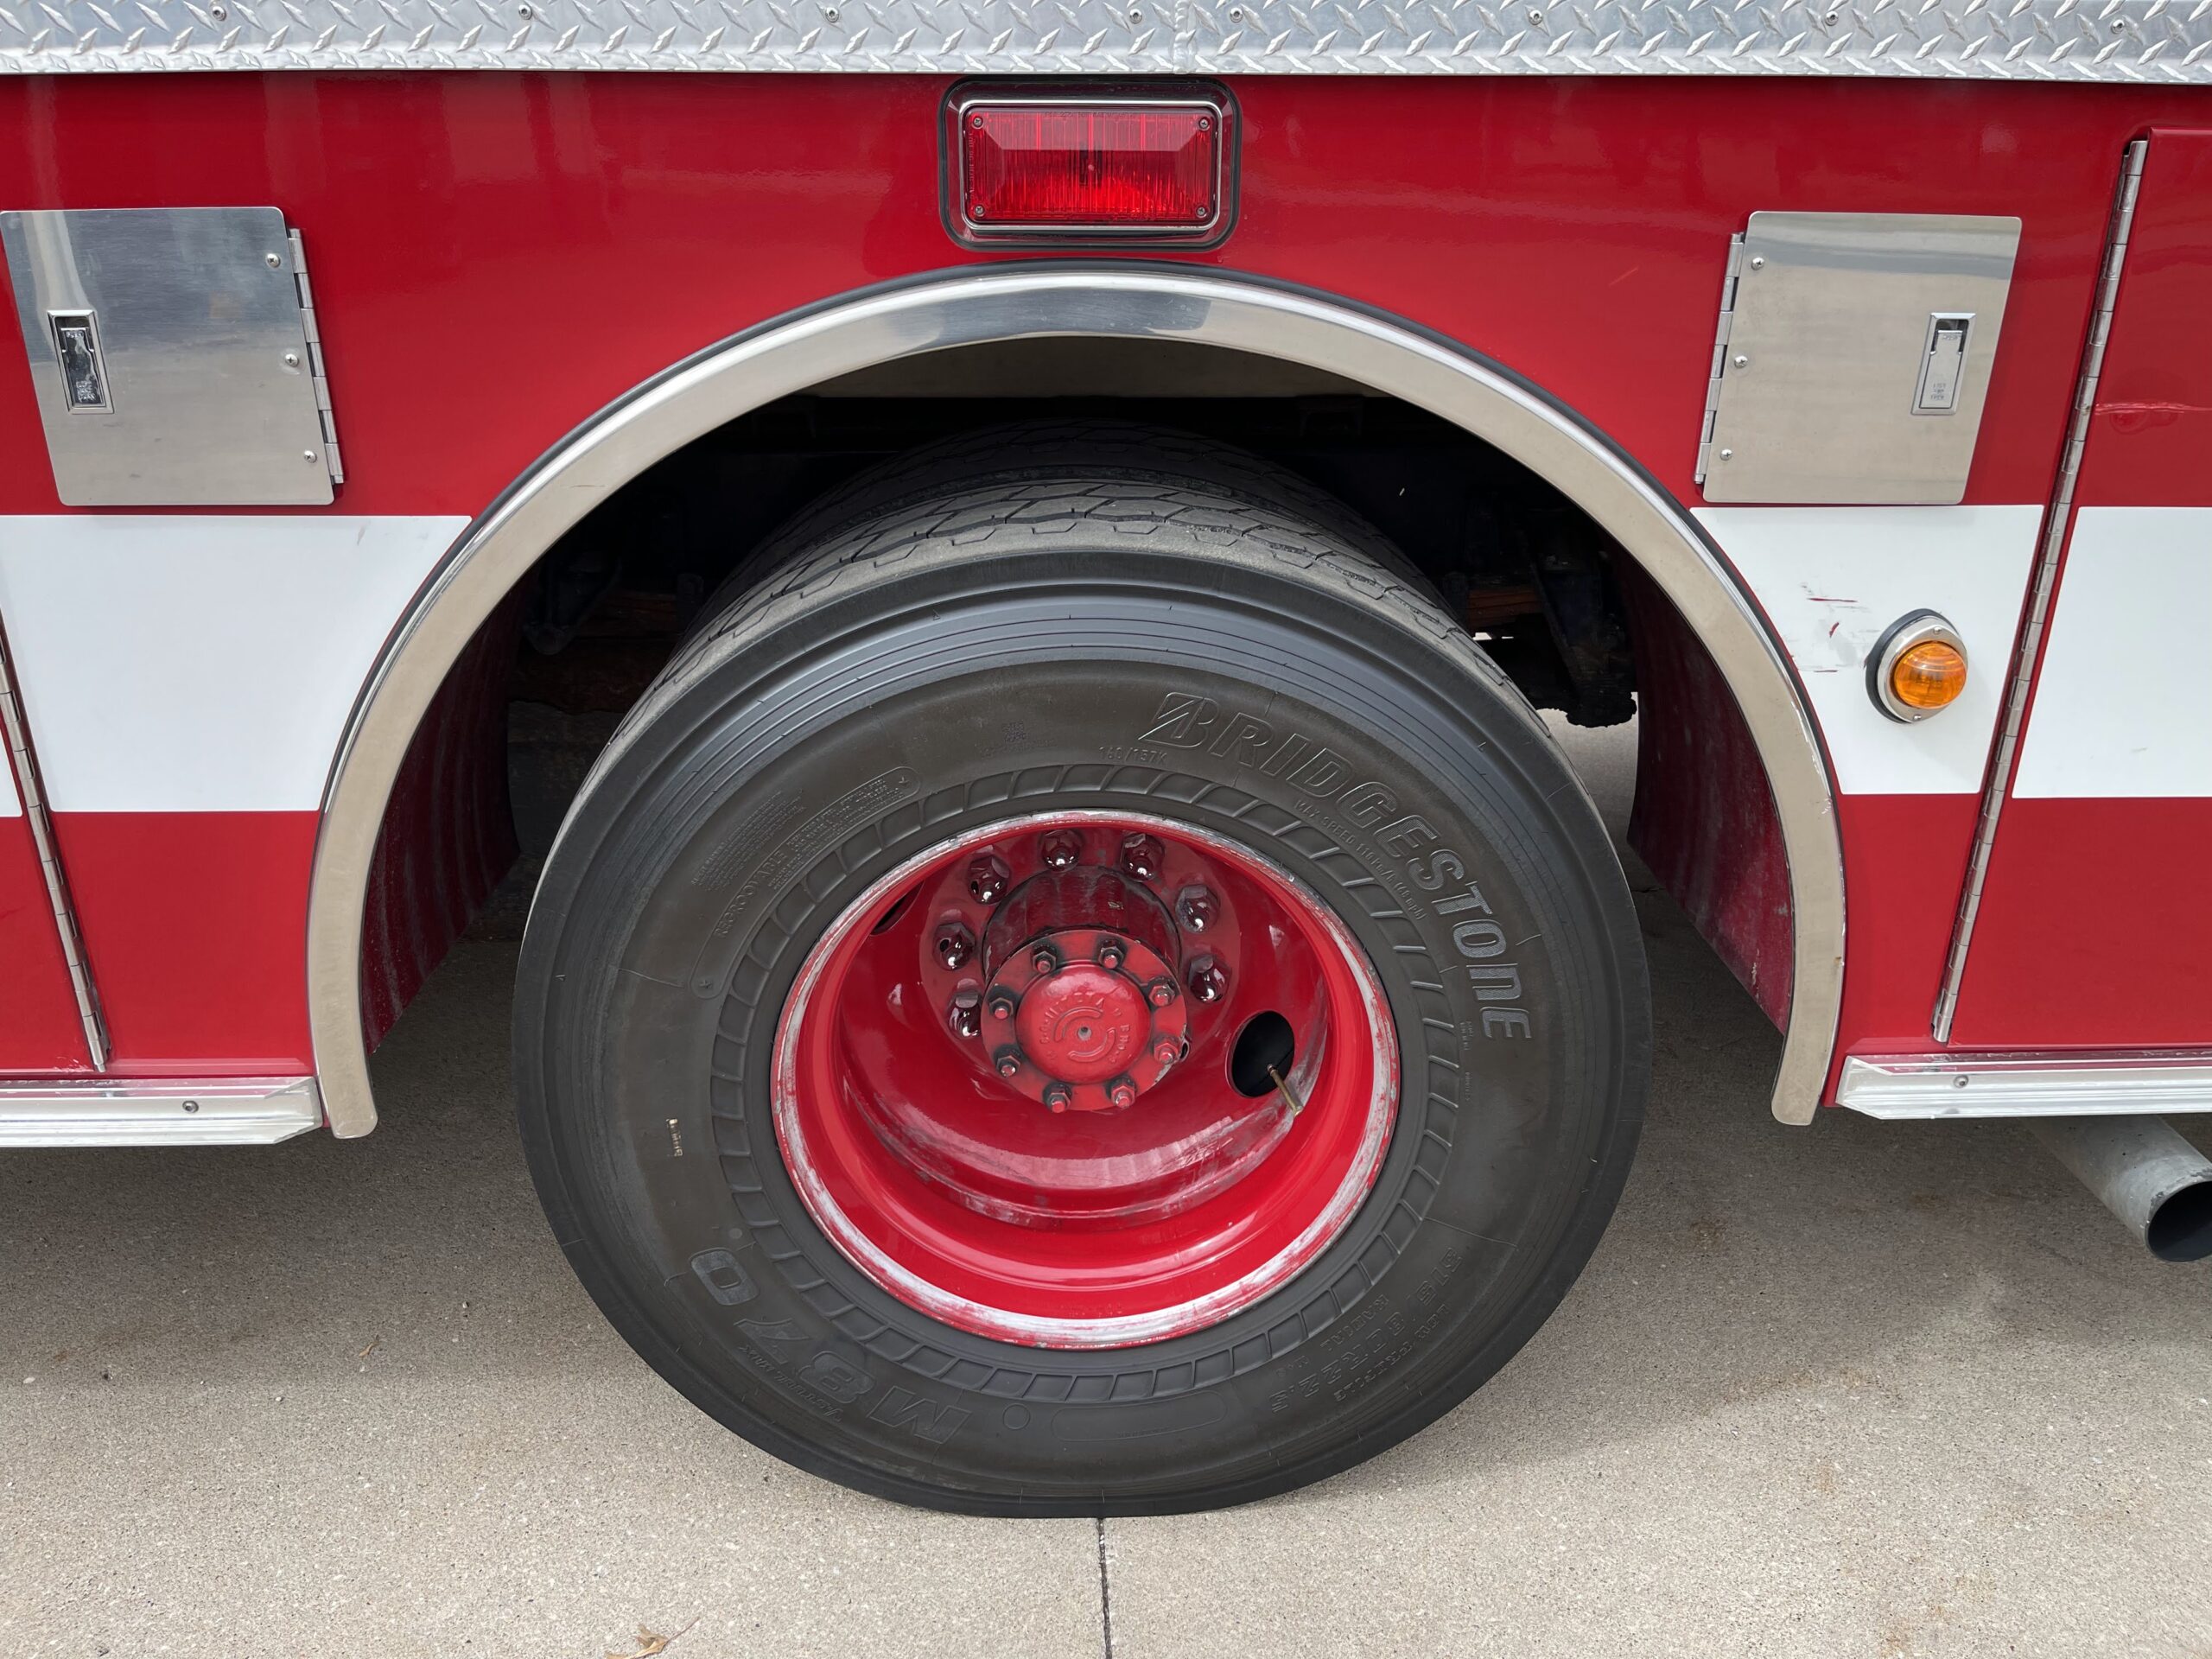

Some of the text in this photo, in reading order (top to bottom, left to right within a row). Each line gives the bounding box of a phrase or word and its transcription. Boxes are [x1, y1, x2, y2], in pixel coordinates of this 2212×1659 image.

[1137, 691, 1533, 1042] BRIDGESTONE
[1319, 815, 1357, 846] SPEED
[690, 1247, 973, 1444] M870
